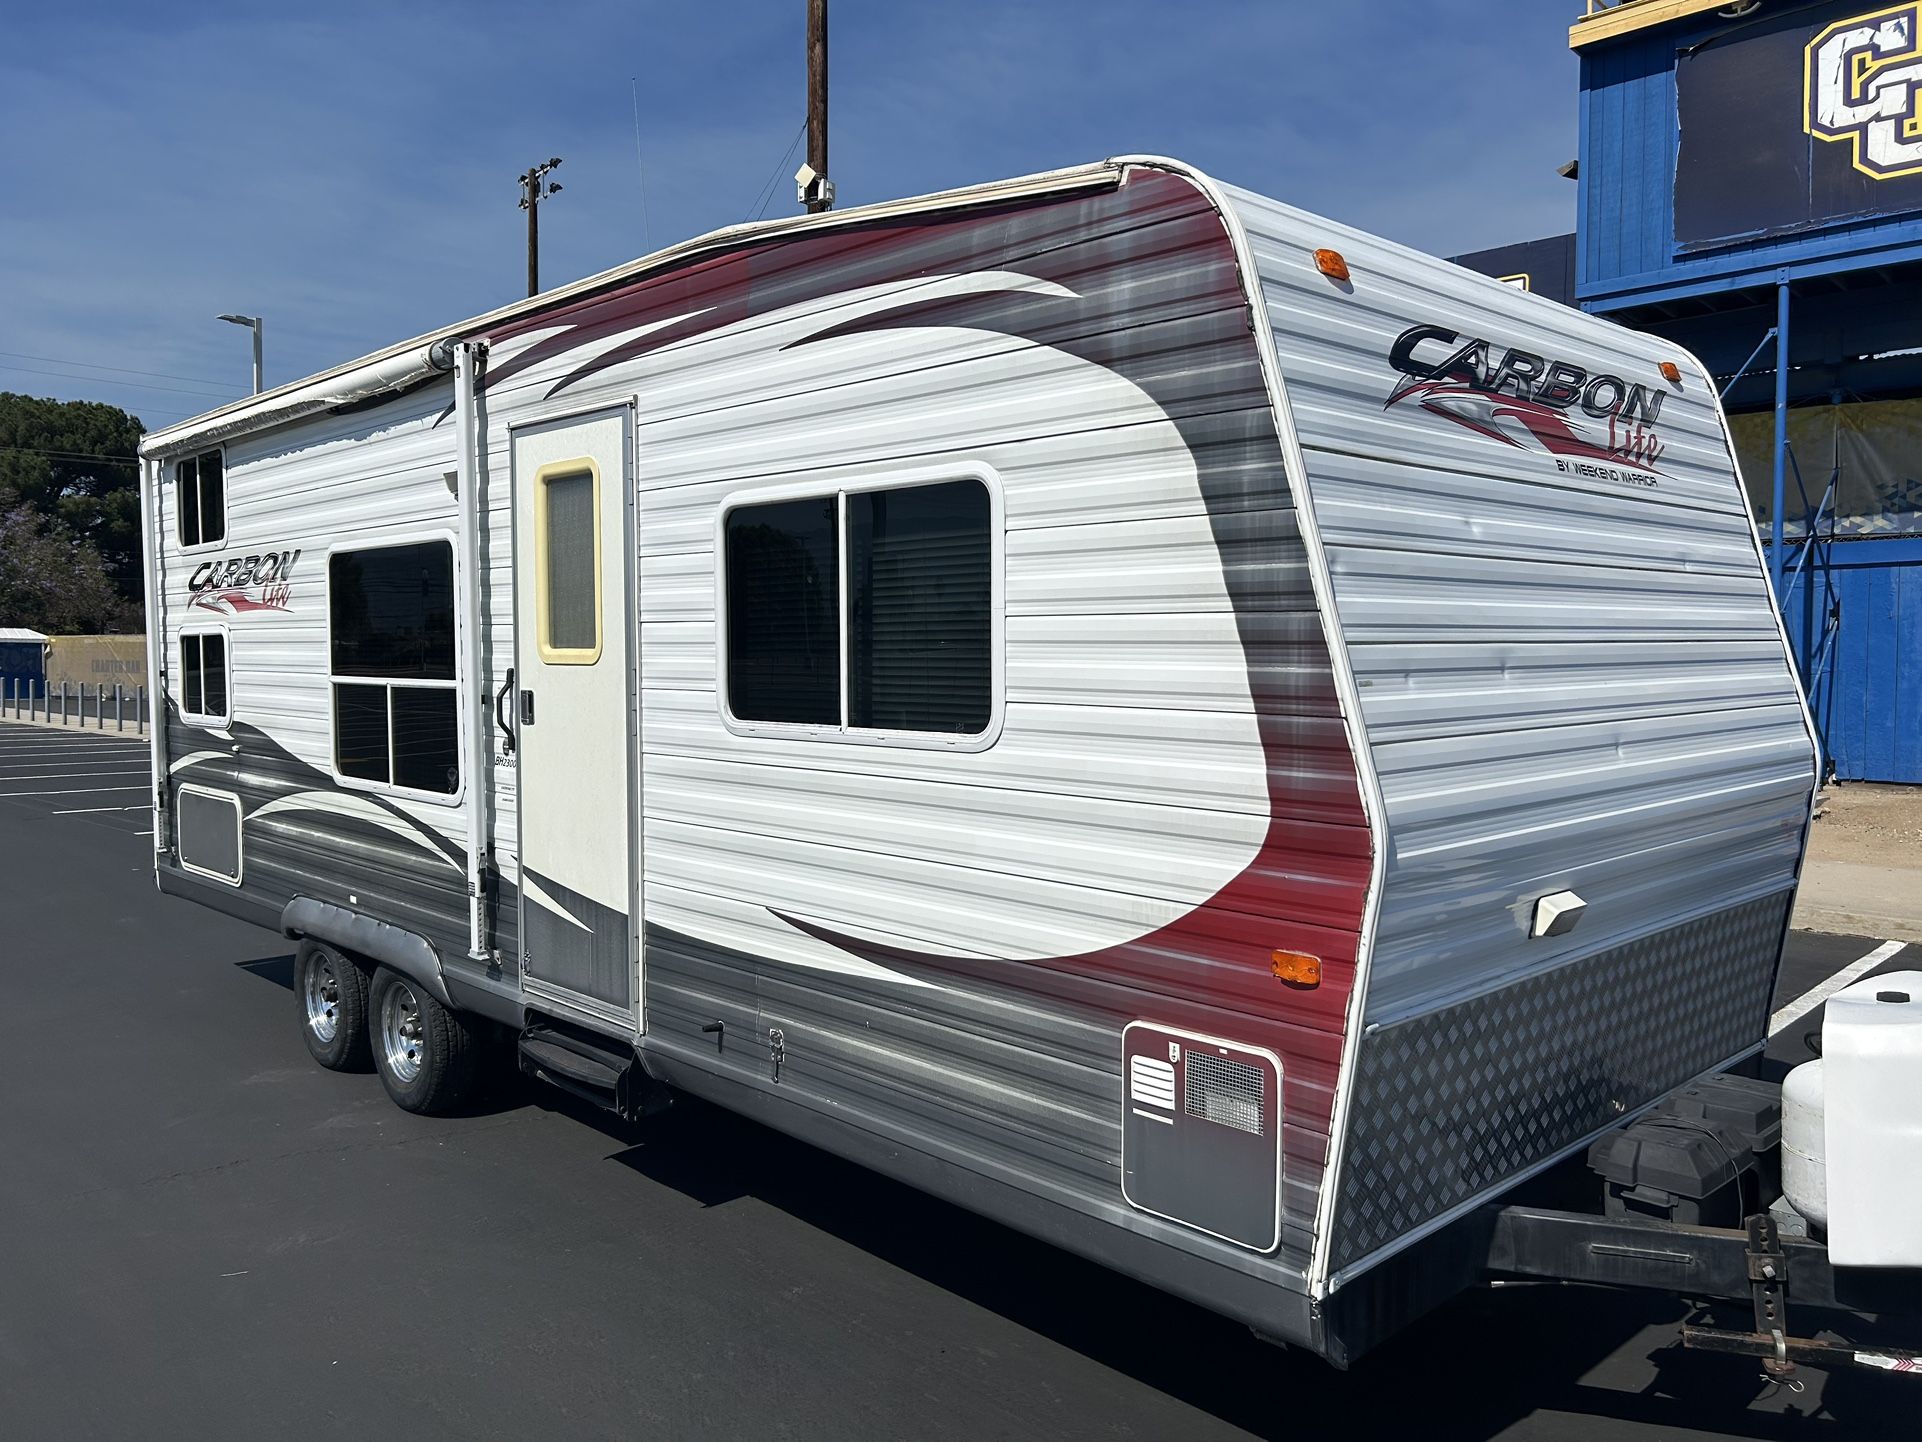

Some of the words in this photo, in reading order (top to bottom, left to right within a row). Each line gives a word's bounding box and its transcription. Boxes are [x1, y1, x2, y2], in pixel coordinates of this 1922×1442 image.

[1387, 324, 1667, 429] CARBON
[1607, 400, 1665, 467] Lite
[1555, 459, 1570, 473] BY
[1572, 462, 1619, 482] WEEKEND
[1620, 471, 1659, 488] WARRIOR
[188, 549, 301, 592] CARBON
